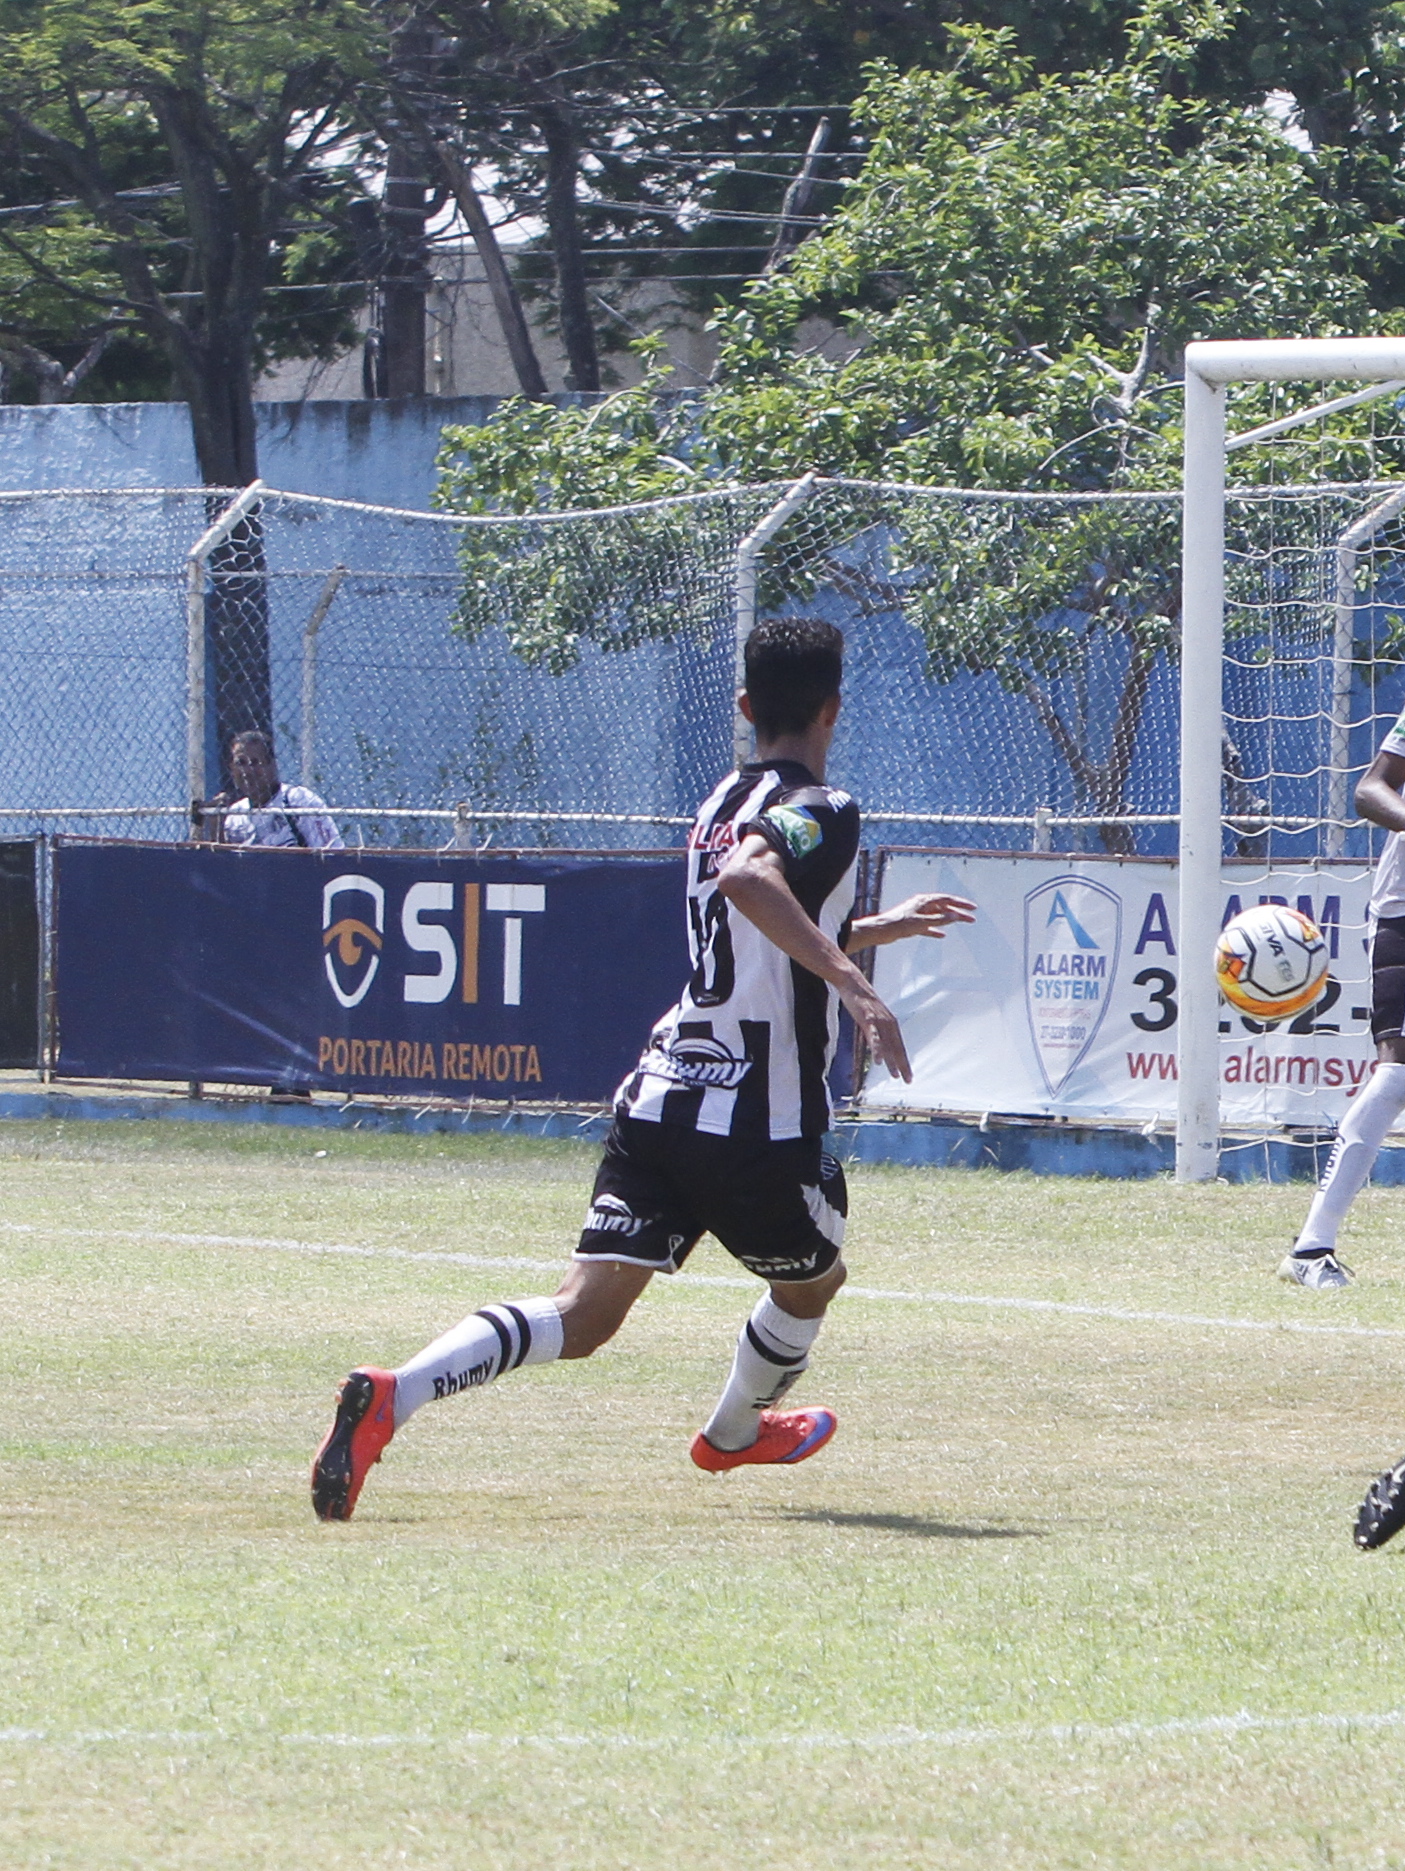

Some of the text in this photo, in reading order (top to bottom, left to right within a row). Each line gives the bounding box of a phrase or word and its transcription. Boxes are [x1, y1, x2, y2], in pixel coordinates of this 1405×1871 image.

[402, 882, 546, 1006] SIT
[1032, 953, 1107, 978] ALARM
[1034, 979, 1099, 1000] SYSTEM
[318, 1035, 543, 1083] PORTARIA REMOTA
[432, 1356, 494, 1401] Rhumy
